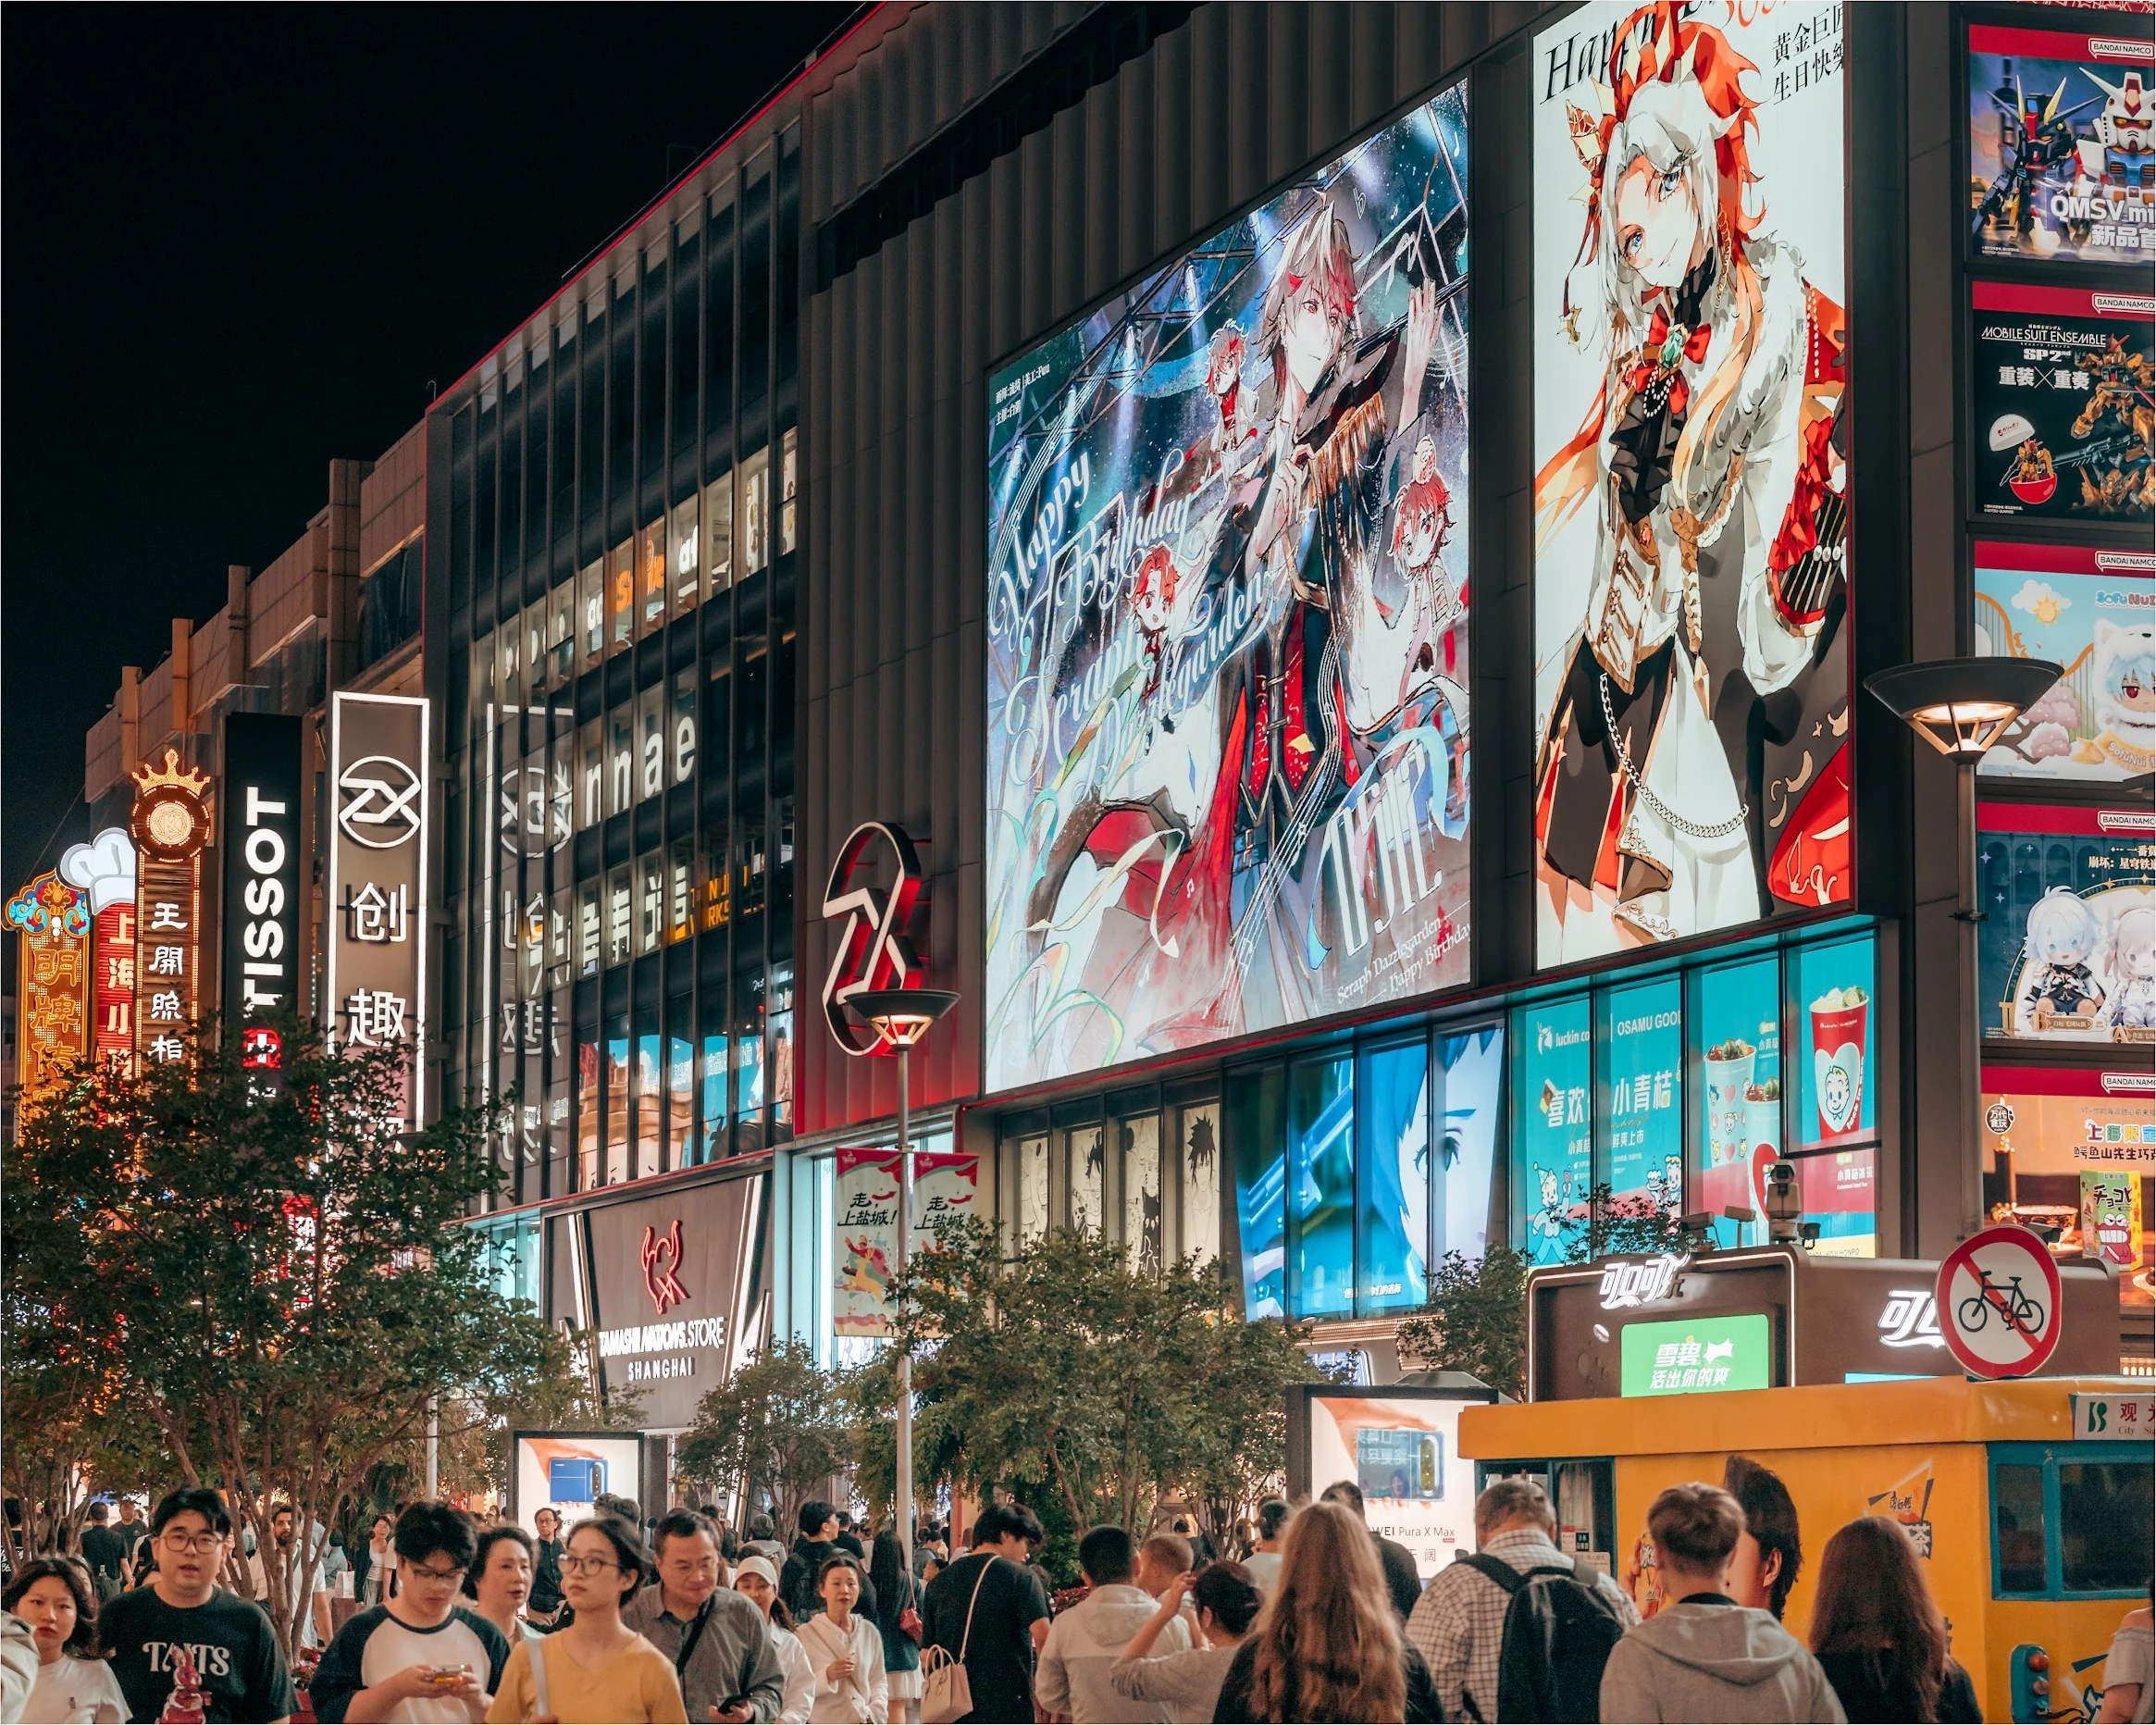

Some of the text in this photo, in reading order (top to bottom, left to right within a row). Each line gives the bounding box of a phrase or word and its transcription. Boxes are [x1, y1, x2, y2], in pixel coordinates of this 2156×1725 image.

[2093, 43, 2151, 56] BANDAI NAMCO
[2050, 194, 2126, 222] QMSV
[2097, 298, 2155, 310] BANDAI NAMCO
[1981, 327, 2107, 346] MOBILE SUIT ENSEMBLE
[989, 450, 1090, 639] Happy
[2100, 556, 2128, 565] BANDAI
[2102, 816, 2131, 825] BANDAI
[243, 786, 286, 1018] TISSOT
[1372, 917, 1442, 978] Dazzlegarden
[147, 901, 188, 1063] 王開照相
[1337, 966, 1372, 1005] Seraph
[30, 949, 81, 1106] 明牌传
[1555, 1031, 1580, 1047] luckin
[1617, 1015, 1653, 1036] OSAMU
[2106, 1077, 2135, 1086] BANDAI
[688, 1316, 725, 1349] STORE
[1653, 1342, 1703, 1367] 雪碧
[628, 1356, 692, 1382] SHANGHAI
[1649, 1367, 1731, 1389] 活出你的爽
[2118, 1425, 2135, 1435] City
[1398, 1526, 1421, 1537] Pura
[1424, 1527, 1431, 1536] X
[1433, 1527, 1456, 1537] Max
